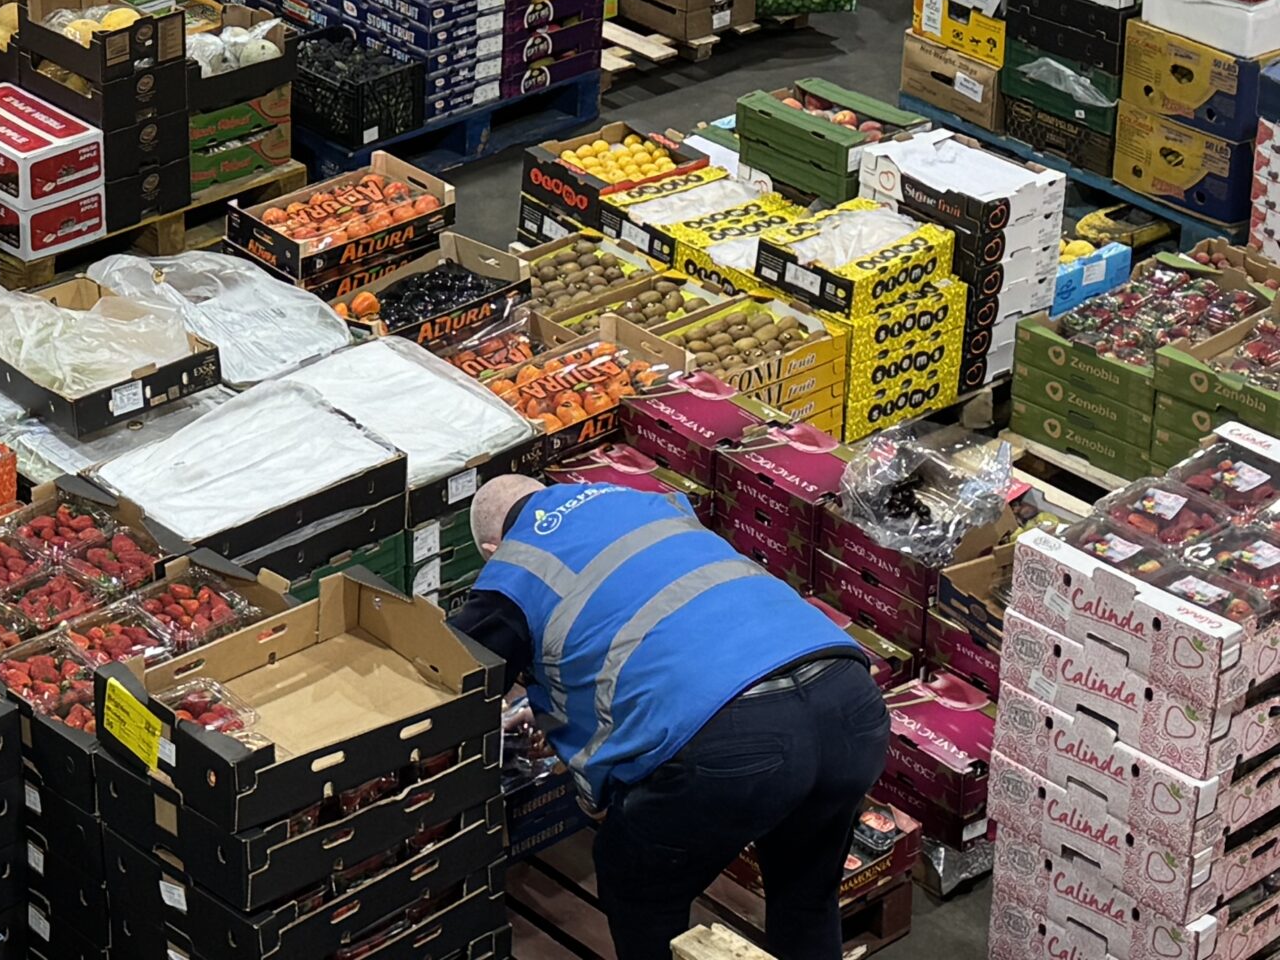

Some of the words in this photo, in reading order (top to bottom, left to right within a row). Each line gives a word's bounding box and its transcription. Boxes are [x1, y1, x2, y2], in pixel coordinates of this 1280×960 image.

[904, 182, 937, 205] Stone
[937, 201, 961, 218] fruit
[340, 224, 415, 264] ALTURA
[419, 303, 491, 340] ALTURA
[787, 352, 817, 373] fruit
[1070, 353, 1121, 386] Zenobia
[787, 377, 816, 398] fruit
[1213, 379, 1267, 413] Zenobia
[1067, 392, 1118, 423] Zenobia
[1065, 431, 1117, 460] Zenobia
[1071, 587, 1145, 638] Calinda
[1060, 658, 1139, 707] Calinda
[1054, 726, 1127, 782] Calinda
[1047, 792, 1121, 849] Calinda
[1052, 870, 1127, 921] Calinda
